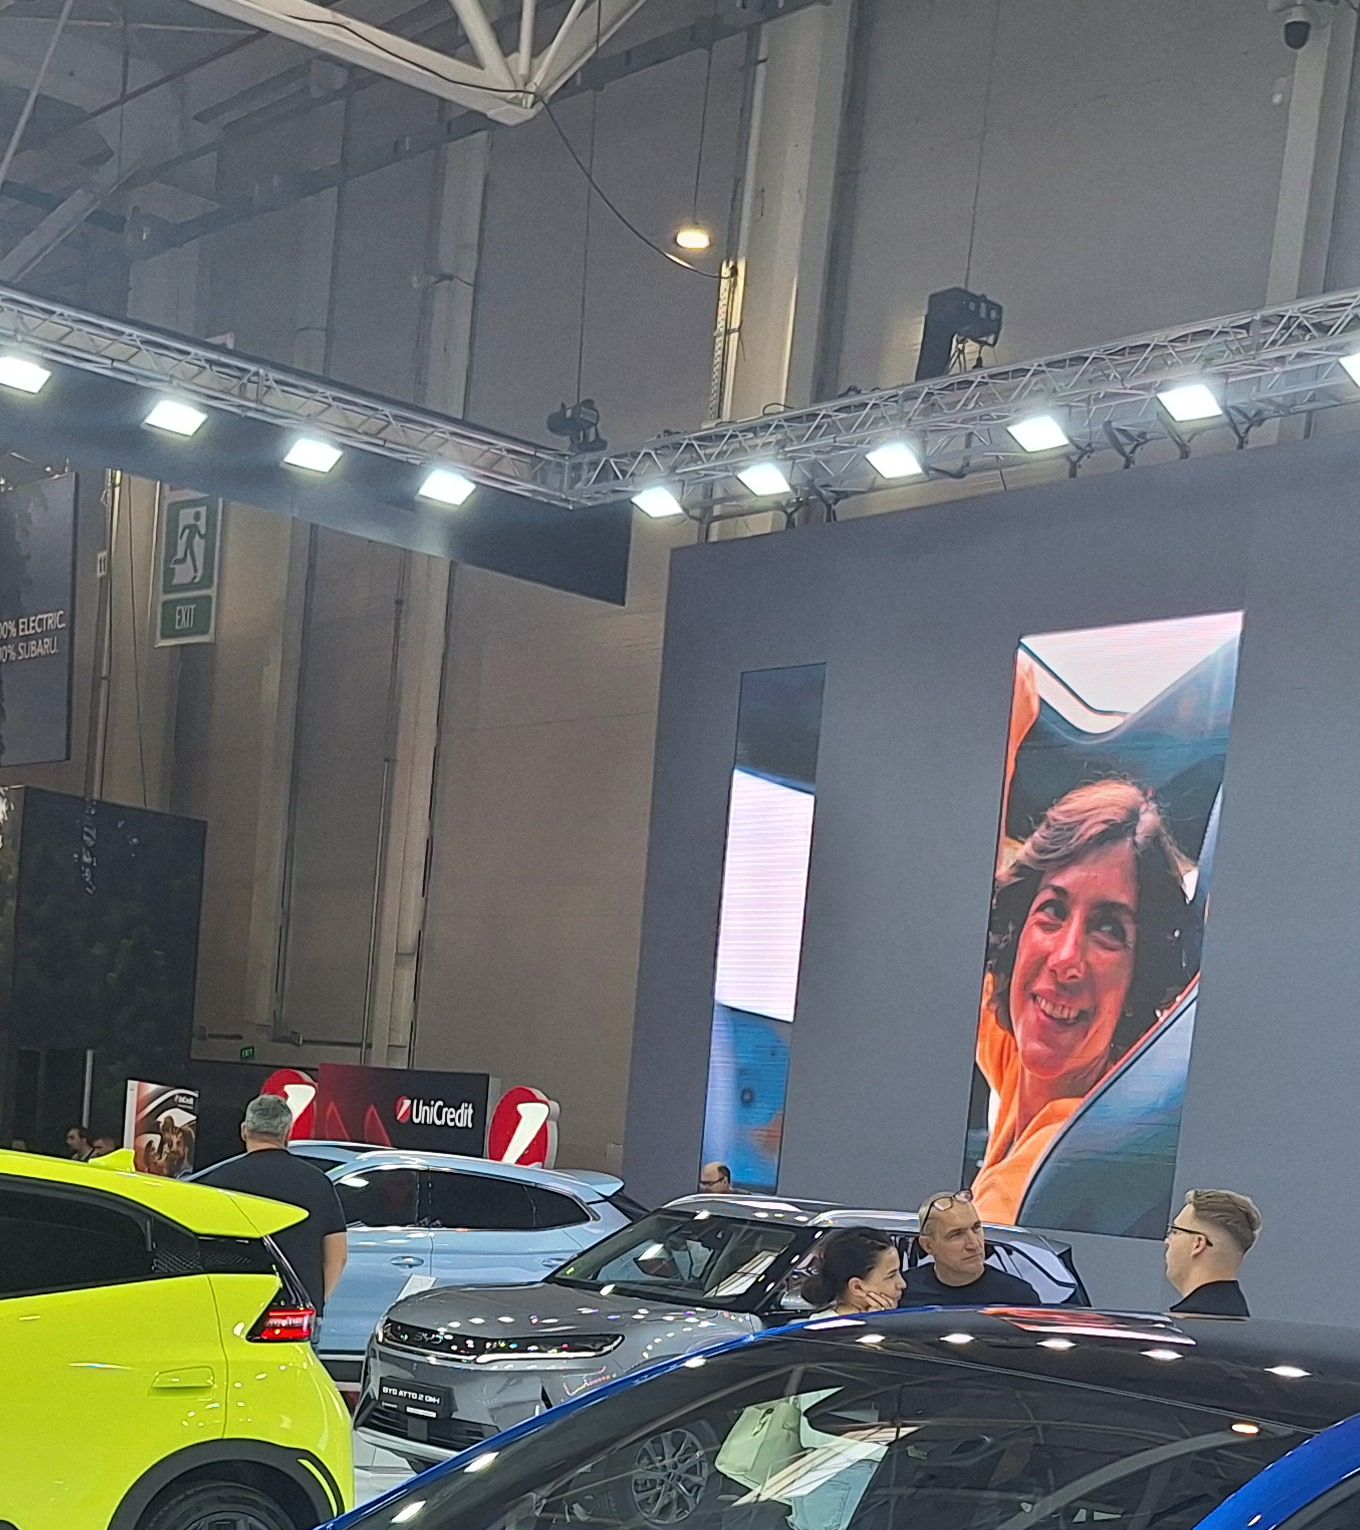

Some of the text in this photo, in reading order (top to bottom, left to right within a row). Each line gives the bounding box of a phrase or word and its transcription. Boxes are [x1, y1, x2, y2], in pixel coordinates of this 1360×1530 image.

[18, 610, 67, 636] ELECTRIC.
[175, 604, 197, 630] EXIT
[17, 636, 59, 661] SUBARU.
[412, 1098, 474, 1129] UniCredit
